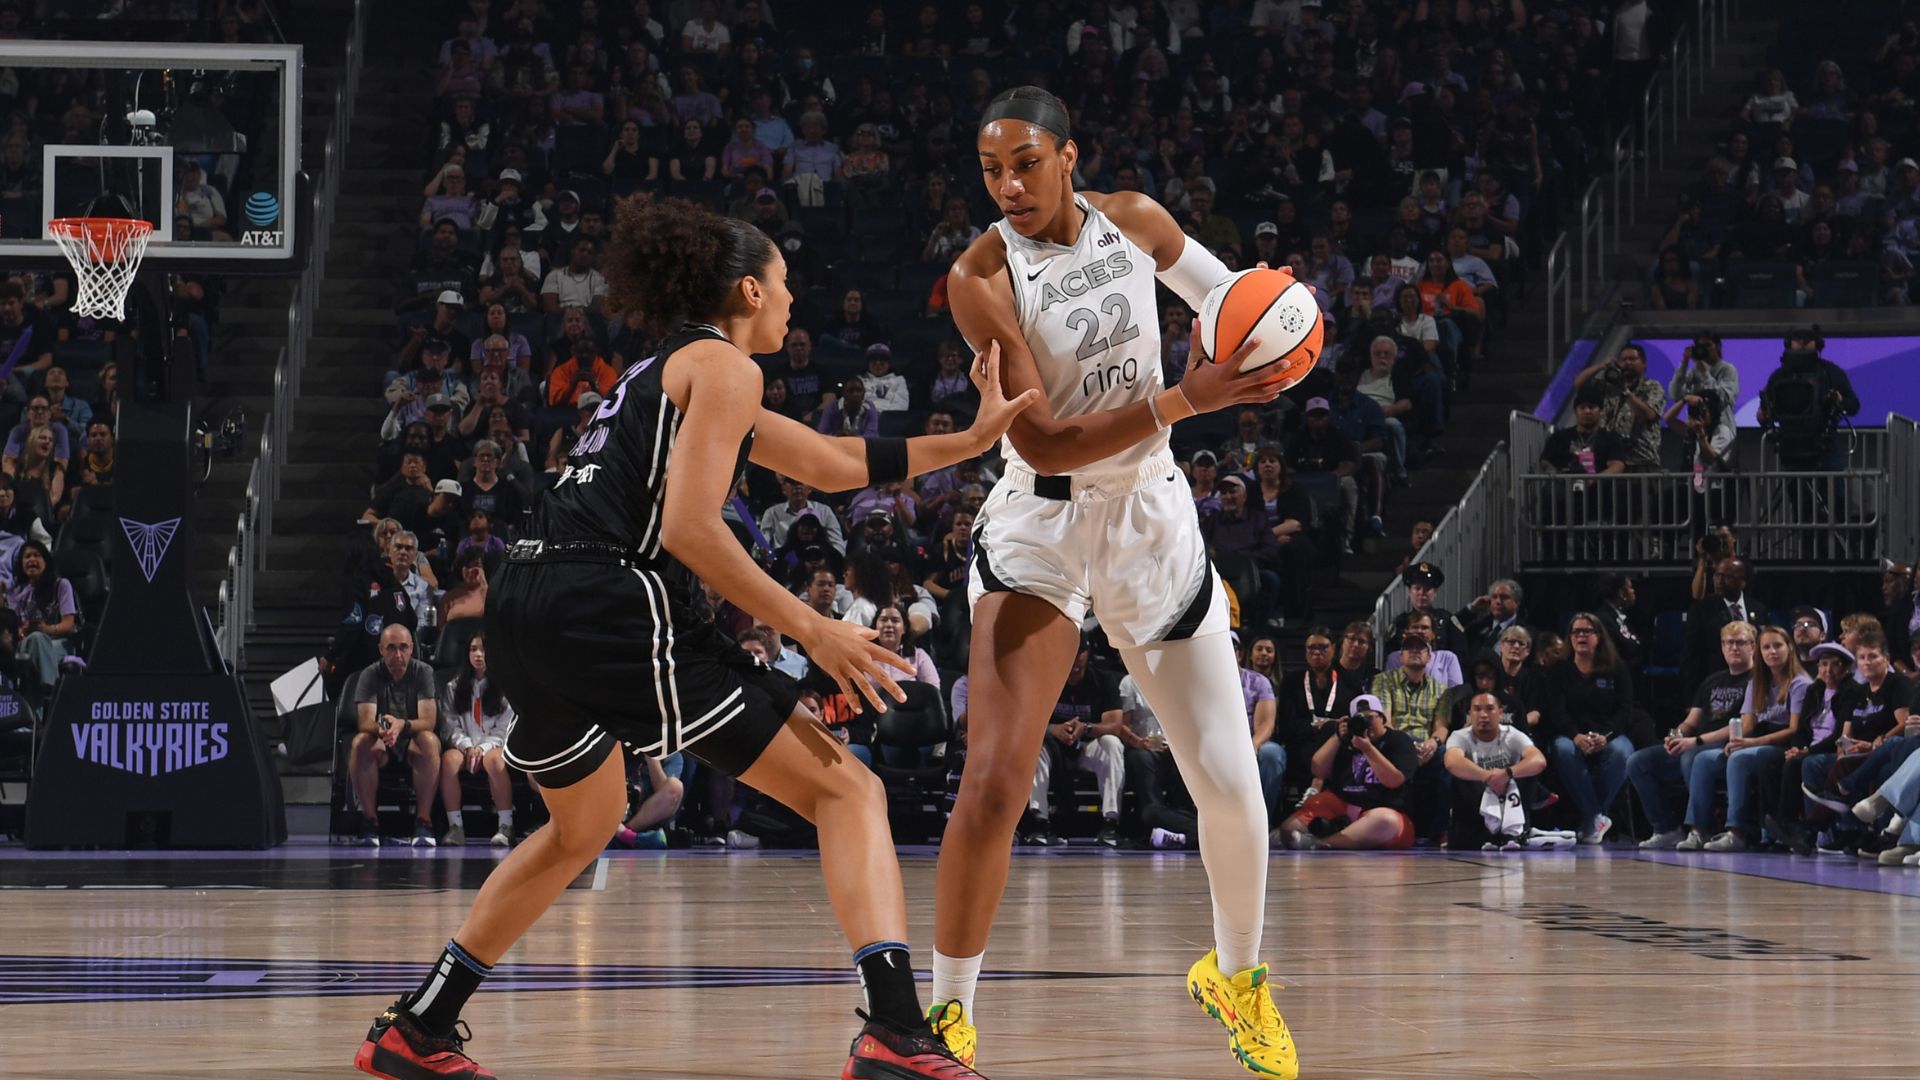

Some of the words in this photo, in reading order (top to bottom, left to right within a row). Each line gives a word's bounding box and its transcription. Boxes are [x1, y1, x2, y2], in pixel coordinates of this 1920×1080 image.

[240, 230, 283, 246] AT&T
[1097, 232, 1121, 248] ally
[1041, 250, 1133, 312] ACES
[1066, 293, 1140, 361] 22
[1083, 358, 1138, 396] ring
[91, 702, 154, 720] GOLDEN
[160, 702, 210, 720] STATE
[71, 723, 229, 776] VALKYRIES
